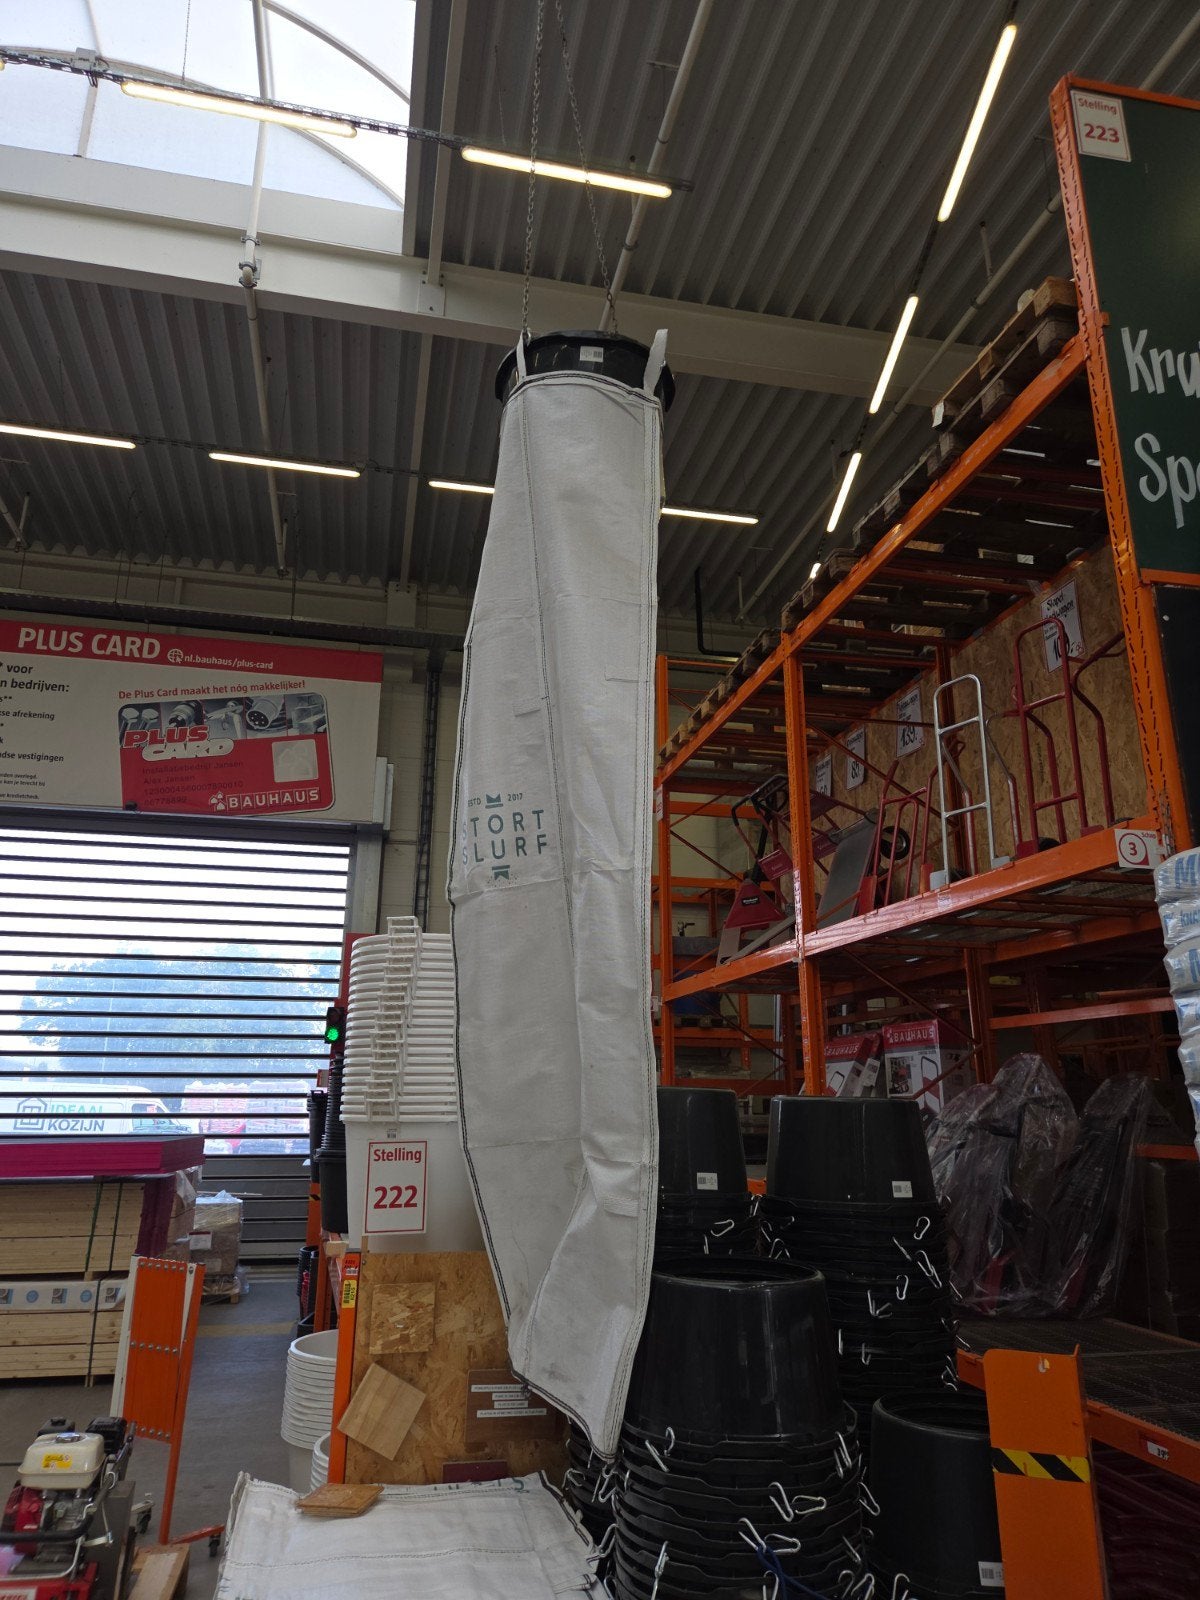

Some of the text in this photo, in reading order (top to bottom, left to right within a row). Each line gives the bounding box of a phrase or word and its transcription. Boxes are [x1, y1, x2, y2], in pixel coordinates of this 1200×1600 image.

[1079, 97, 1117, 115] Stelling
[1084, 123, 1120, 143] 223
[1134, 432, 1200, 529] Sp
[18, 627, 274, 670] PLUS CARD nl.bauhaus/plus-card
[7, 665, 34, 674] voor
[11, 678, 70, 692] bedrijven:
[118, 680, 305, 699] De Plus Card maakt het nóg makkelijker!
[12, 710, 55, 721] afrekening
[123, 725, 209, 748] PLUS
[18, 753, 64, 762] vestigingen
[142, 738, 234, 762] CARD
[230, 789, 319, 809] BAUHAUS
[507, 793, 523, 802] 2017
[1128, 842, 1138, 856] 3
[893, 1026, 934, 1043] BAUHAUS
[47, 1119, 105, 1132] KOZIJN
[373, 1147, 422, 1164] Stelling
[373, 1185, 418, 1209] 222
